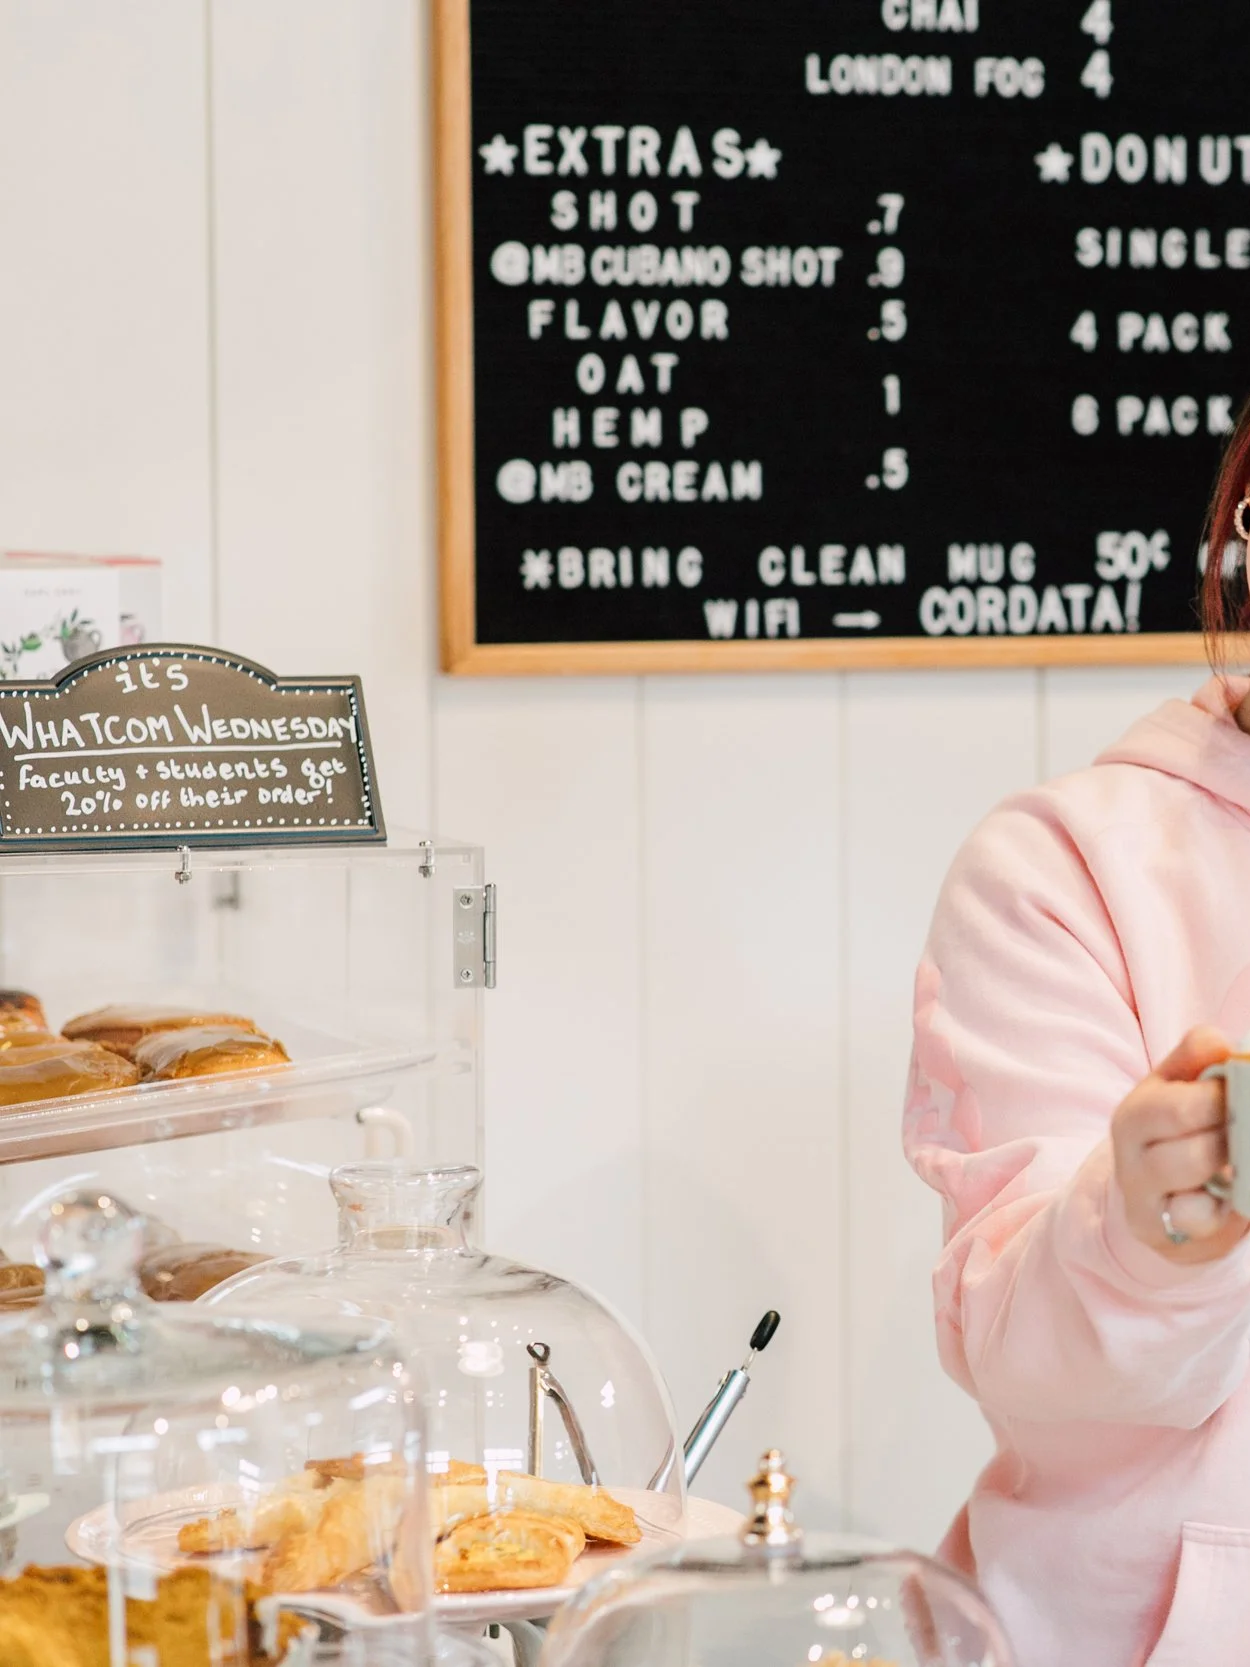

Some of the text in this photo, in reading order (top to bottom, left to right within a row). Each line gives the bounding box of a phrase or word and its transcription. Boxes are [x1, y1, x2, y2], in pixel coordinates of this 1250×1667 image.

[882, 0, 1113, 44] CHAI 4
[806, 50, 1113, 98] LONDON FOG 4
[551, 190, 904, 234] SHOT .7
[591, 244, 731, 286] CUBANO
[741, 247, 842, 287] SHOT
[528, 299, 728, 340] FLAVOR
[1071, 311, 1231, 351] 4 PACK
[577, 353, 900, 414] OAT 1
[553, 407, 708, 448] HEMP
[1072, 395, 1232, 435] 6 PACK
[617, 461, 762, 502] CREAM
[866, 448, 908, 489] .5
[759, 544, 905, 586] CLEAN
[948, 543, 1035, 583] MUG
[704, 581, 1141, 639] WIFI CORDATA!
[0, 701, 357, 750] WHATCOM WEDNESDAY
[301, 757, 348, 789] get
[60, 780, 334, 816] 20% off their order!
